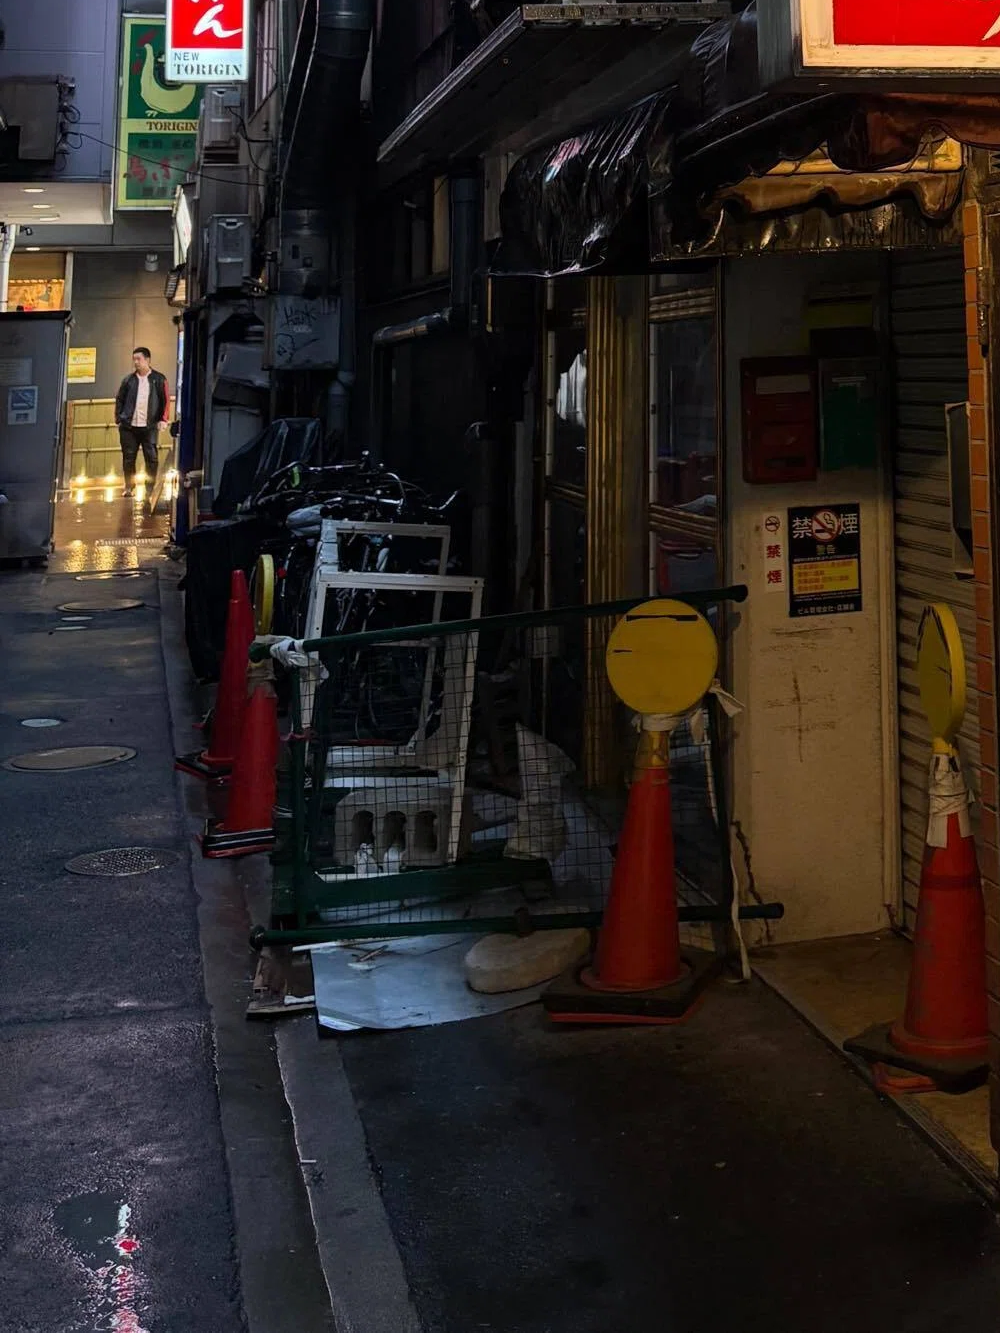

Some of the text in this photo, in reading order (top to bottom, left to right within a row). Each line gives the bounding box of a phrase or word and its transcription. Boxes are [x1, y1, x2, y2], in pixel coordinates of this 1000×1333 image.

[173, 52, 200, 62] NEW
[173, 63, 242, 77] TORIGIN
[146, 121, 198, 132] TORIGIN
